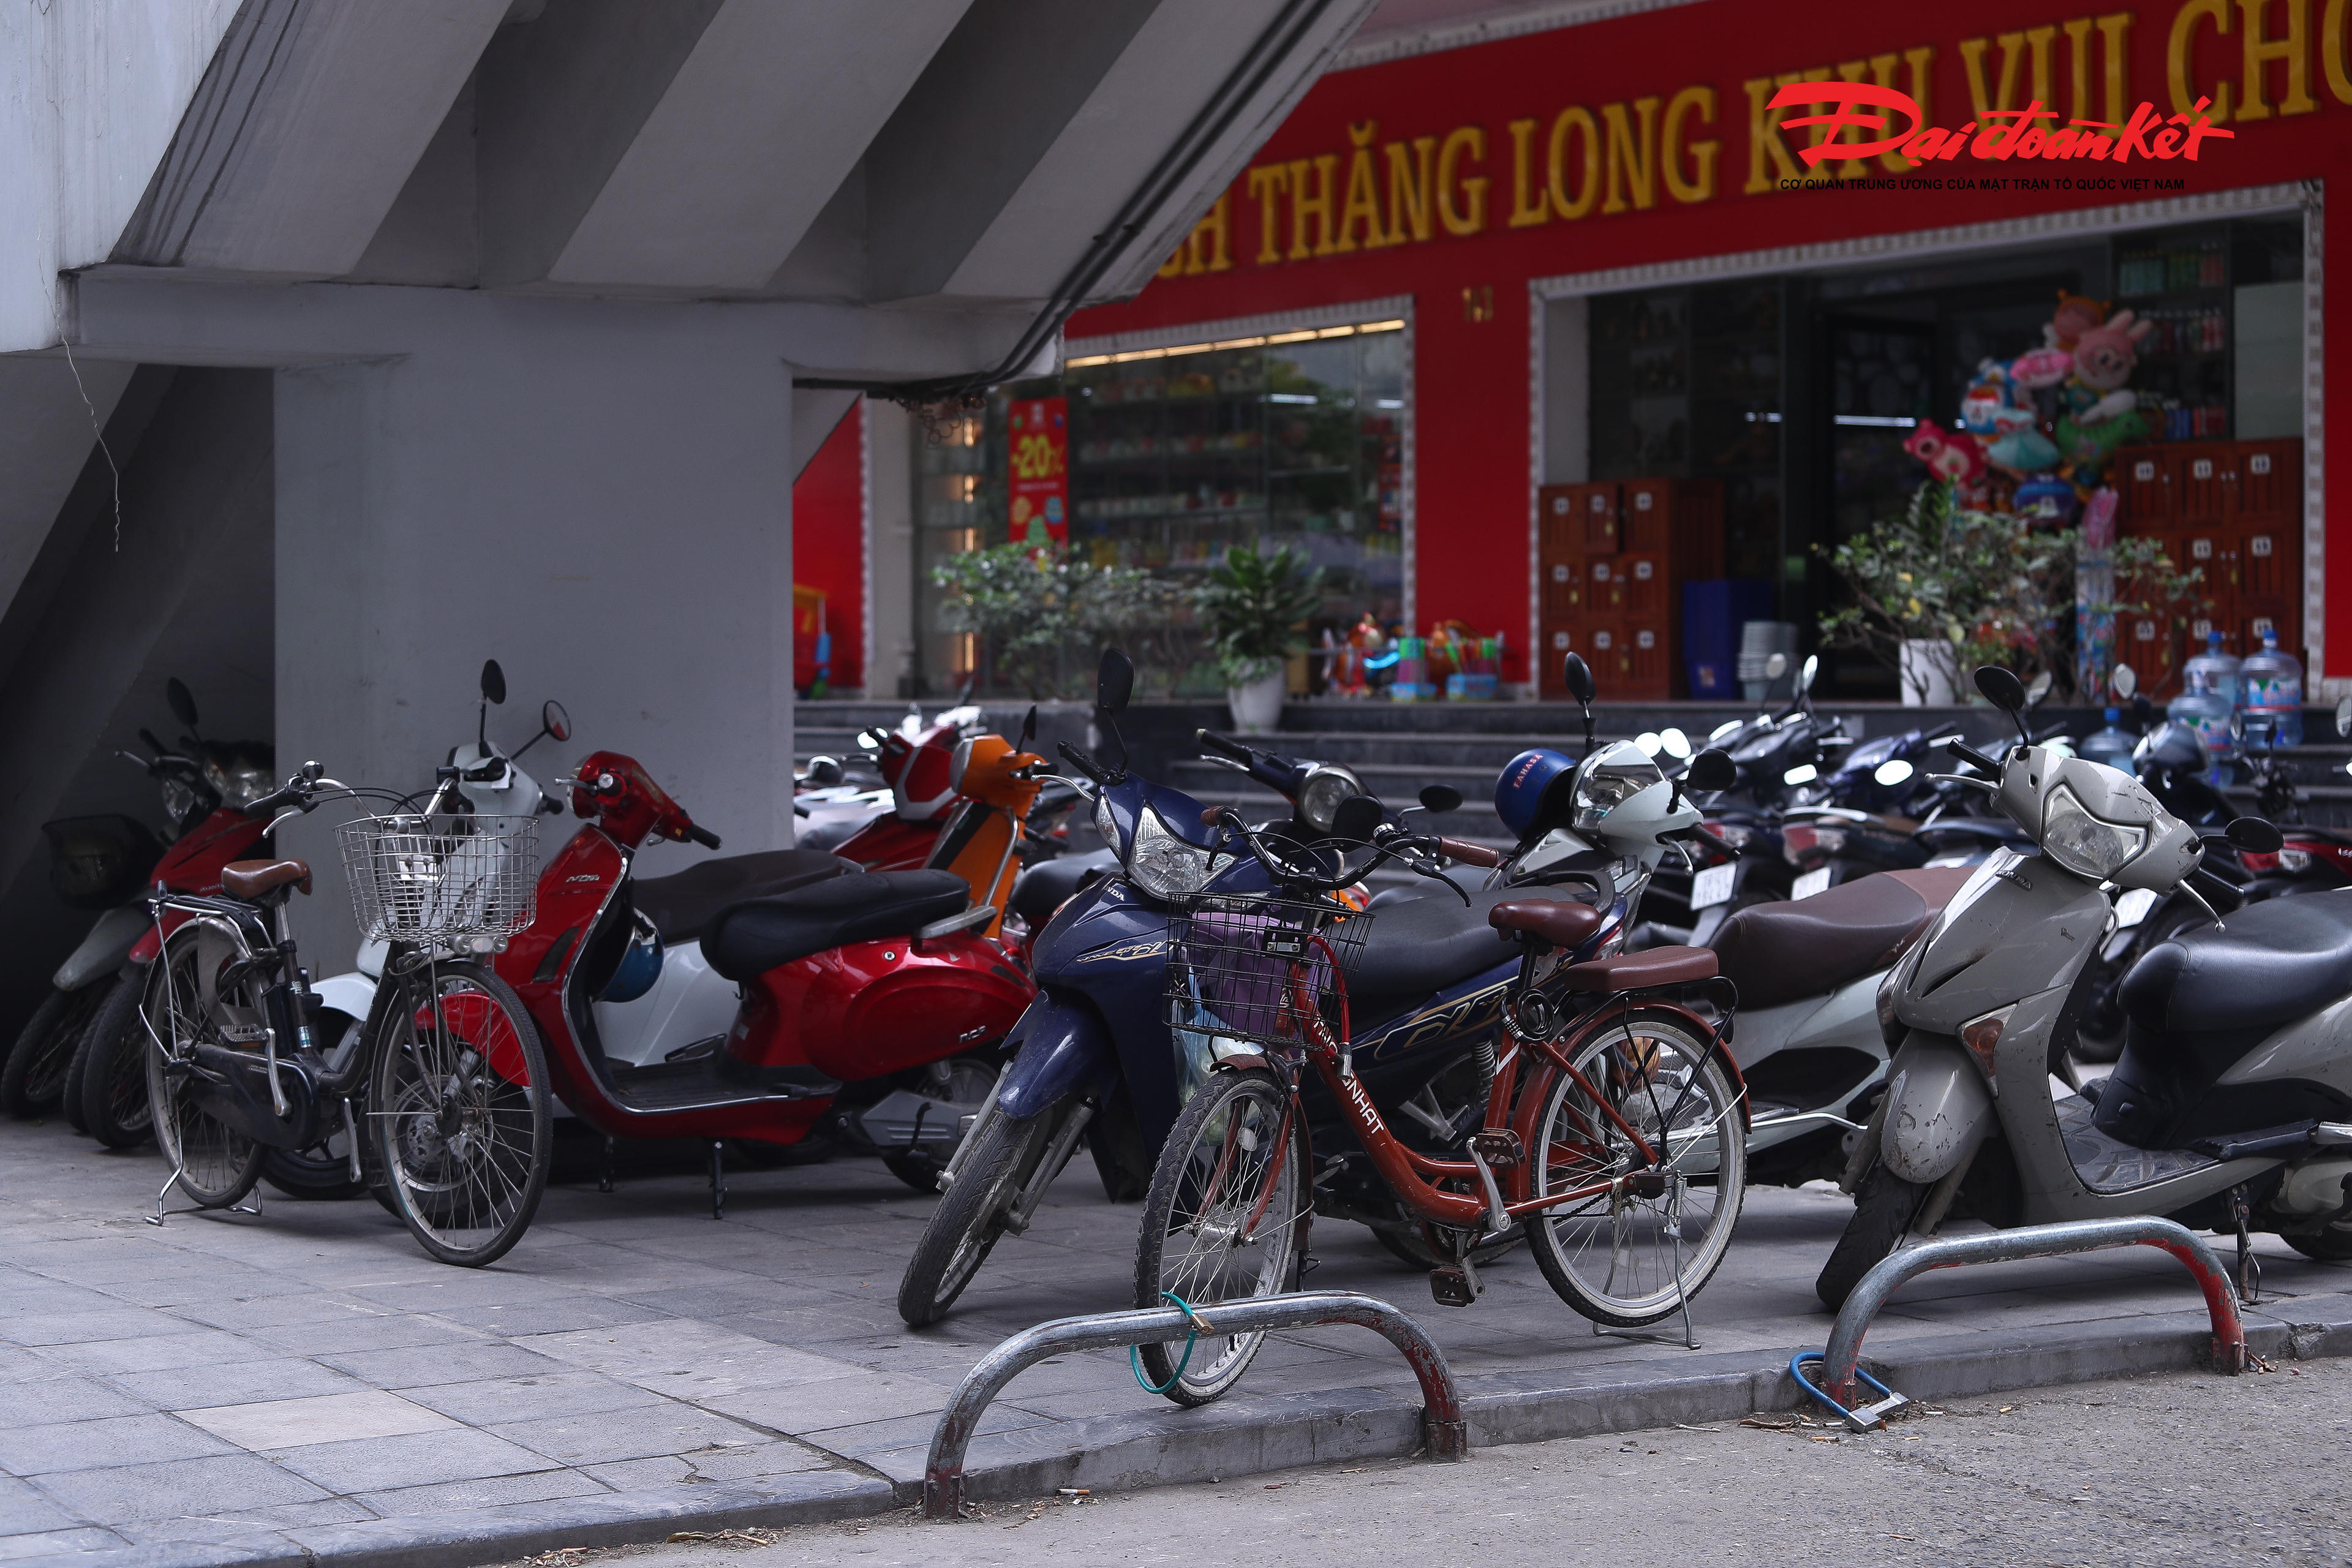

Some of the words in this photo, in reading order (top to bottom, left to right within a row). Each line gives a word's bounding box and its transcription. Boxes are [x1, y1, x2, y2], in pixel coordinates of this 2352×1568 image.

[1248, 119, 1488, 265] THĂNG
[1507, 86, 1720, 228] LONG
[1513, 754, 1544, 788] FAHASA
